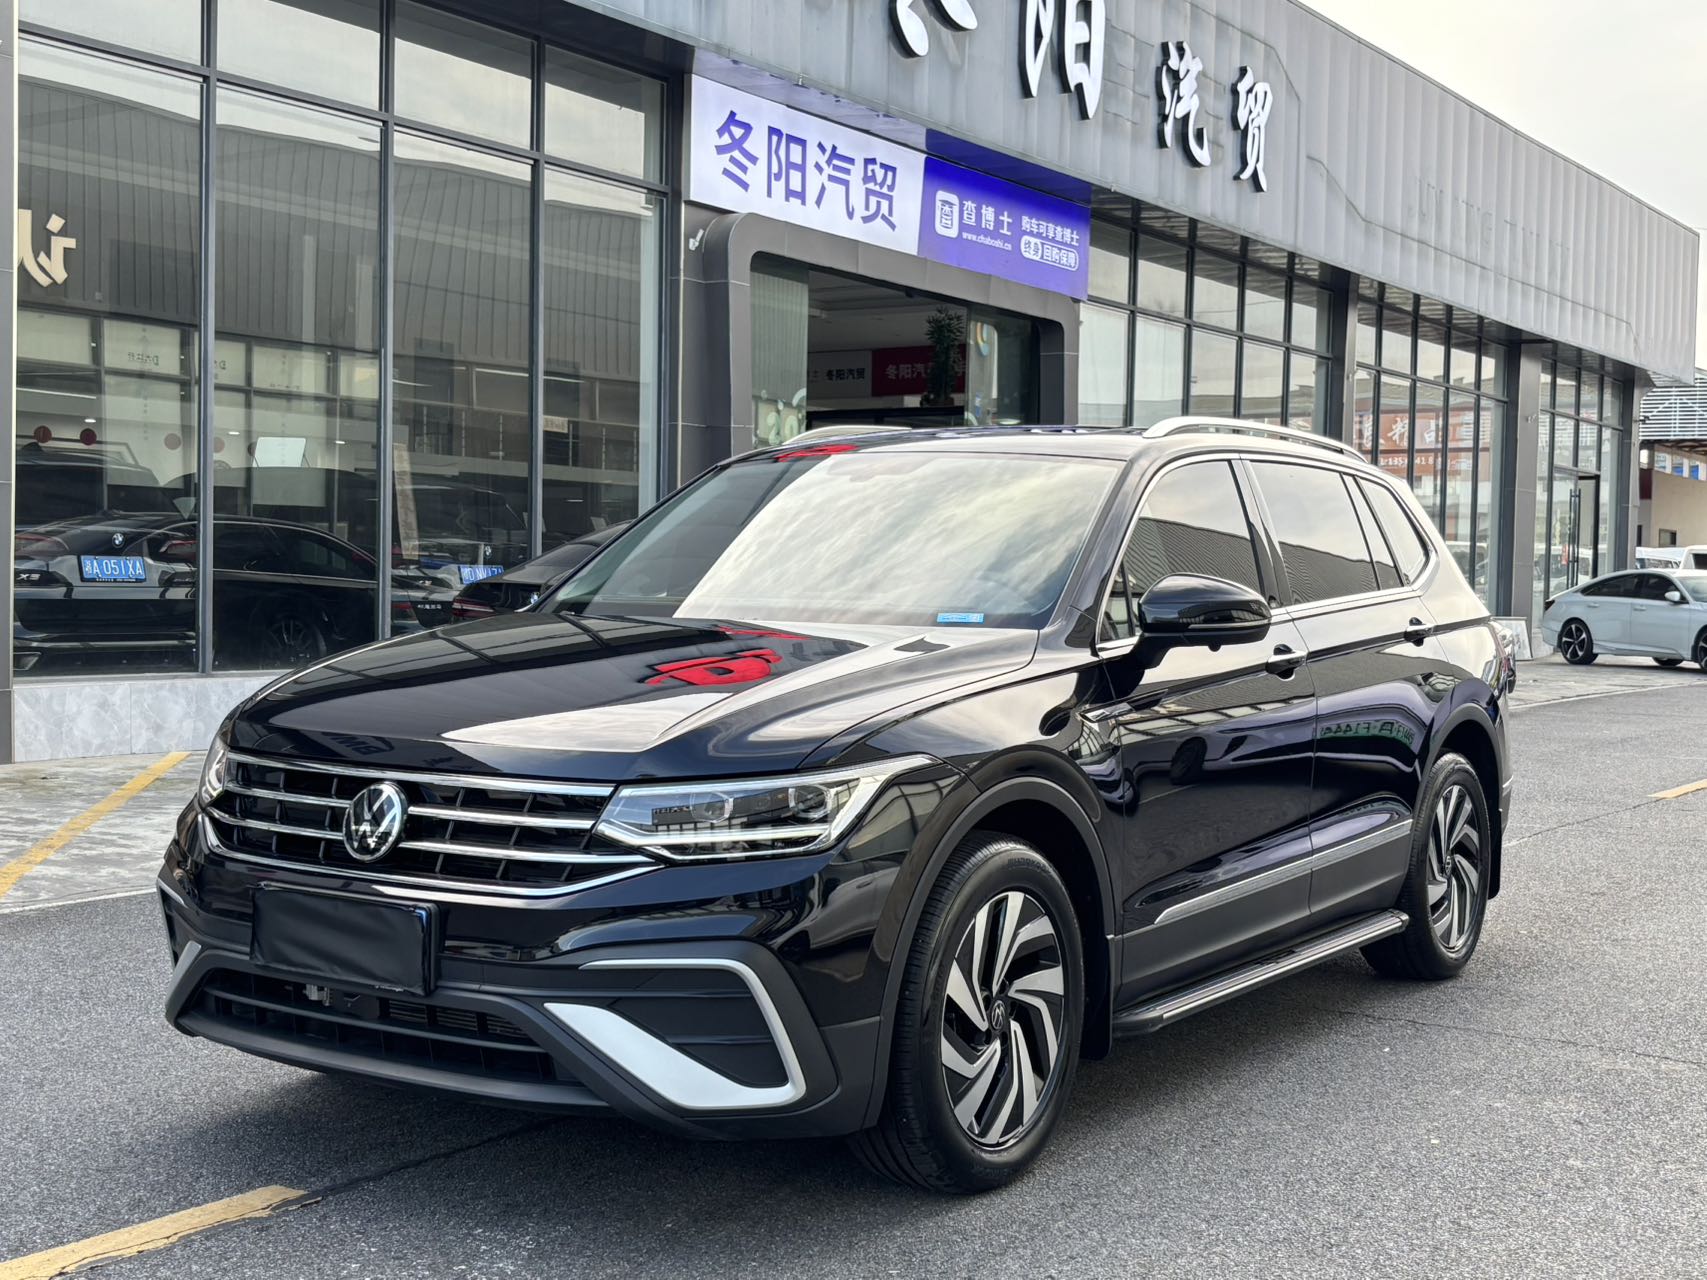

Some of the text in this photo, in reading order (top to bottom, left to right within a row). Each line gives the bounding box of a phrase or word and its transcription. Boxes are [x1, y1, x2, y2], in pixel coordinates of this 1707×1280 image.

[714, 109, 897, 231] 冬阳汽贸
[962, 200, 1013, 236] 查博士
[1021, 215, 1080, 246] 购车可享查博士
[962, 231, 1012, 251] www.chaboshi.cn
